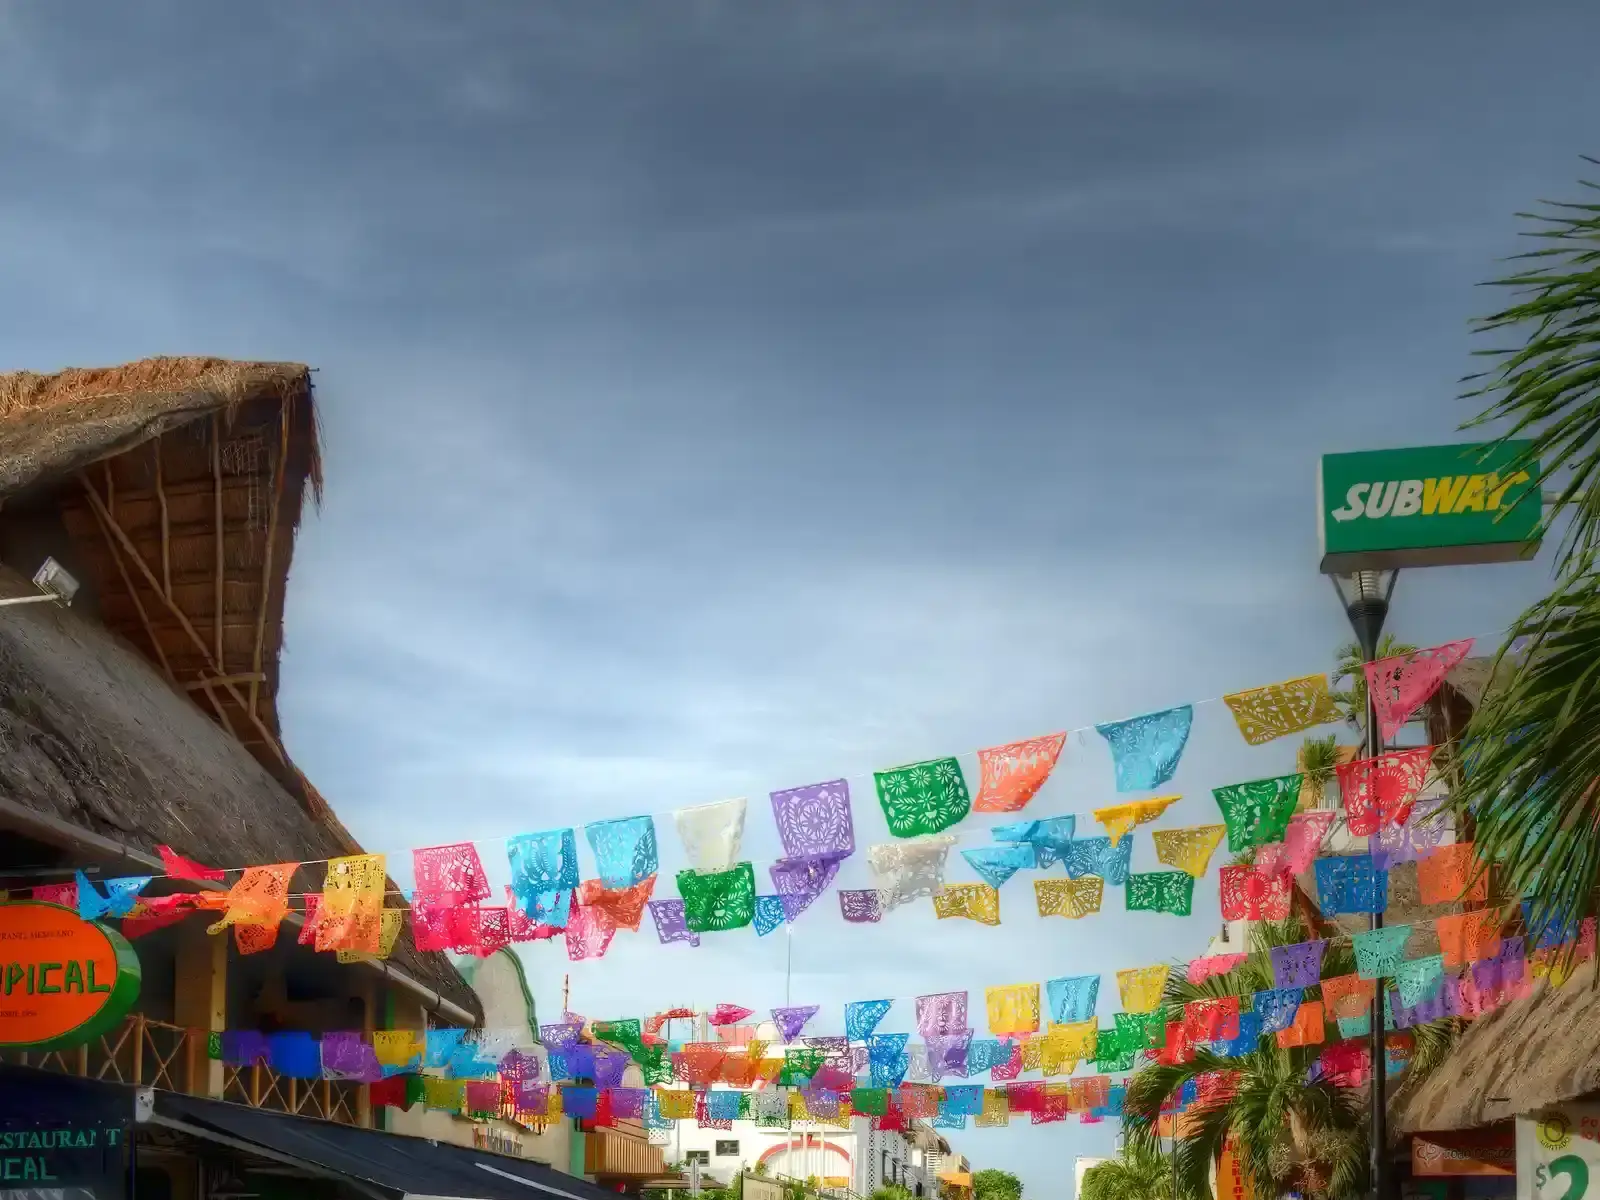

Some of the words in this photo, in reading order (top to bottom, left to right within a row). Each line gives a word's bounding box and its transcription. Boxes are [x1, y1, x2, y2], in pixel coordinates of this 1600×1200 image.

[1331, 469, 1531, 523] SUBWAY
[0, 960, 111, 996] PICAL
[0, 1156, 58, 1181] CAL
